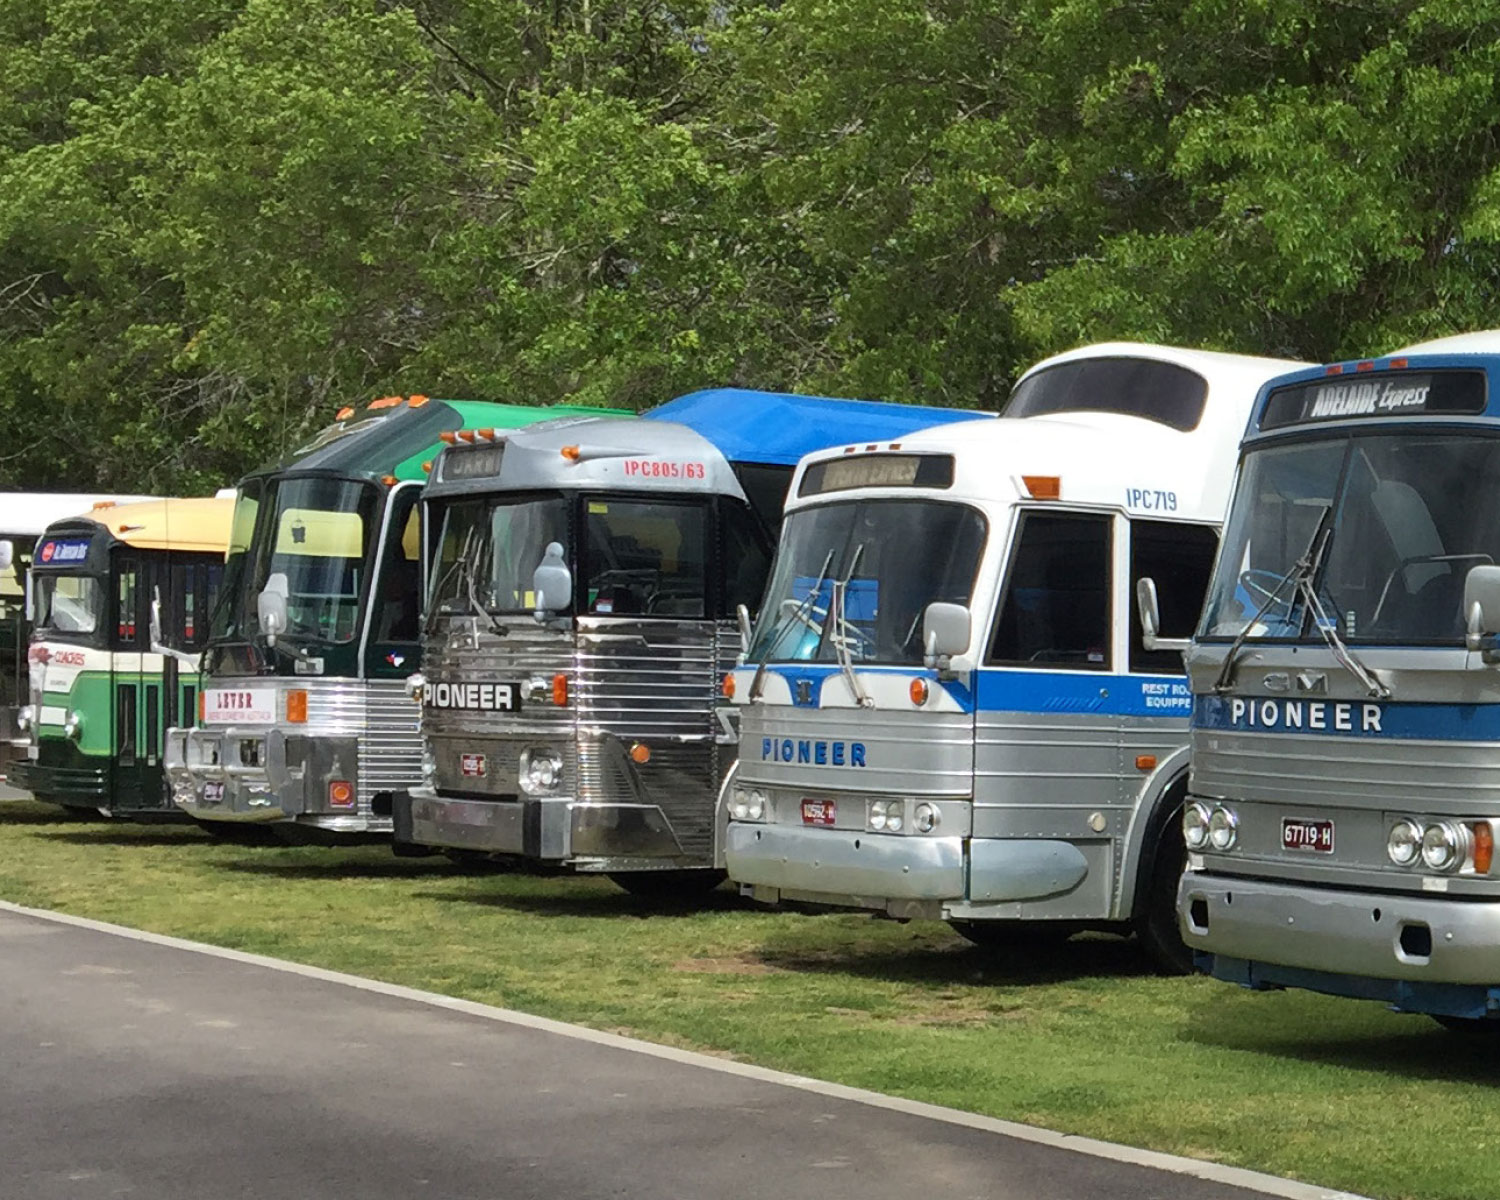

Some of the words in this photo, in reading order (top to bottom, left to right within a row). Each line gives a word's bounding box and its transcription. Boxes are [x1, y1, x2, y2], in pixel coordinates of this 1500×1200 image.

[1311, 383, 1381, 417] ADELAIDE
[1379, 382, 1430, 410] Express
[624, 461, 705, 479] IPC805/63
[1126, 488, 1177, 511] IPC719
[217, 692, 252, 709] LEVER
[423, 683, 512, 709] PIONEER
[1142, 683, 1169, 694] REST
[1232, 700, 1382, 732] PIONEER
[762, 738, 867, 768] PIONEER
